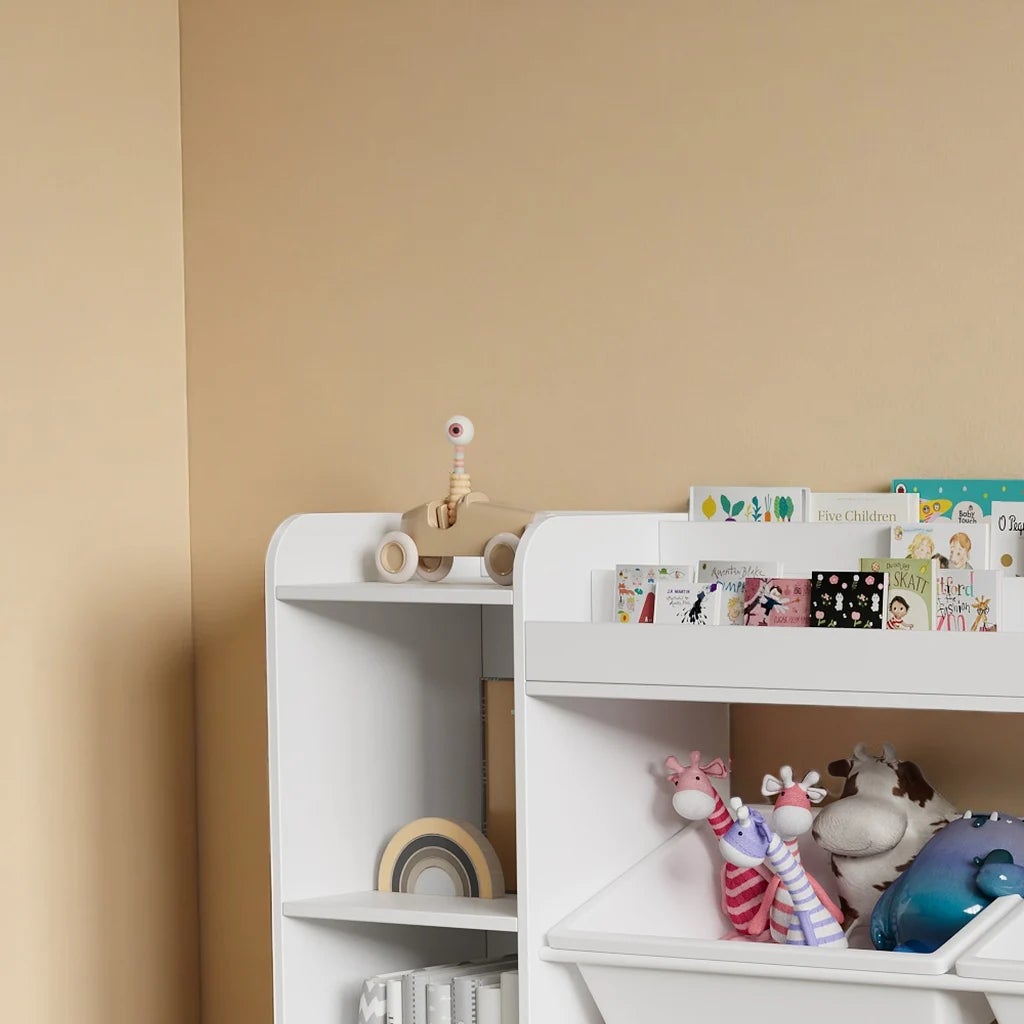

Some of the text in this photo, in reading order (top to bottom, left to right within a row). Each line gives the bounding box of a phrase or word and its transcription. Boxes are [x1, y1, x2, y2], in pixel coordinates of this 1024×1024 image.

[818, 511, 897, 522] Five Children
[958, 510, 975, 519] Baby
[893, 571, 930, 593] SKATT
